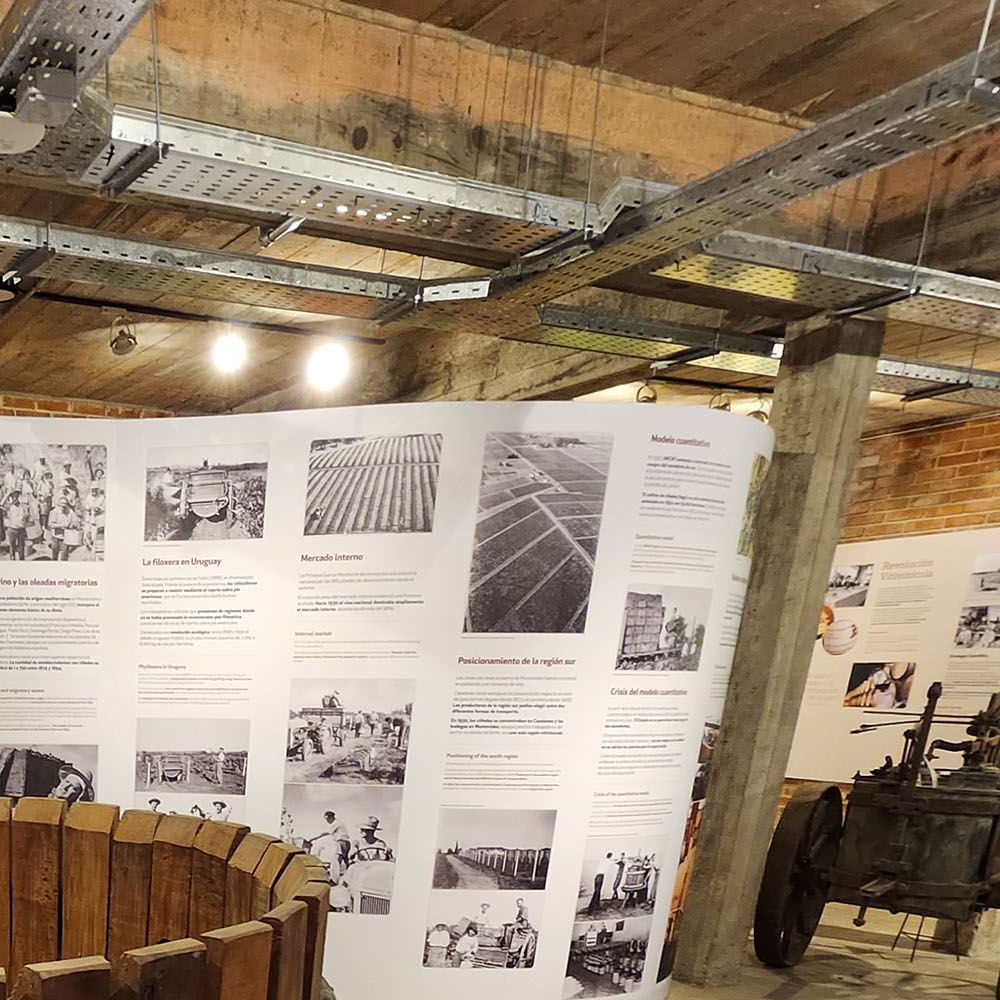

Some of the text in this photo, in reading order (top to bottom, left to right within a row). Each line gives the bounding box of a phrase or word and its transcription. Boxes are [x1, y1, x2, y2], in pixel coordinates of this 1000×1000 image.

[300, 553, 364, 562] Mercado interno
[142, 558, 151, 566] La
[152, 558, 179, 566] filoxera
[191, 558, 222, 567] Uruguay
[12, 580, 18, 588] y
[58, 578, 98, 588] migratorias
[458, 657, 520, 665] Posicionamiento
[522, 657, 530, 665] de
[532, 657, 538, 665] la
[540, 657, 563, 666] región
[610, 688, 628, 696] Crisis
